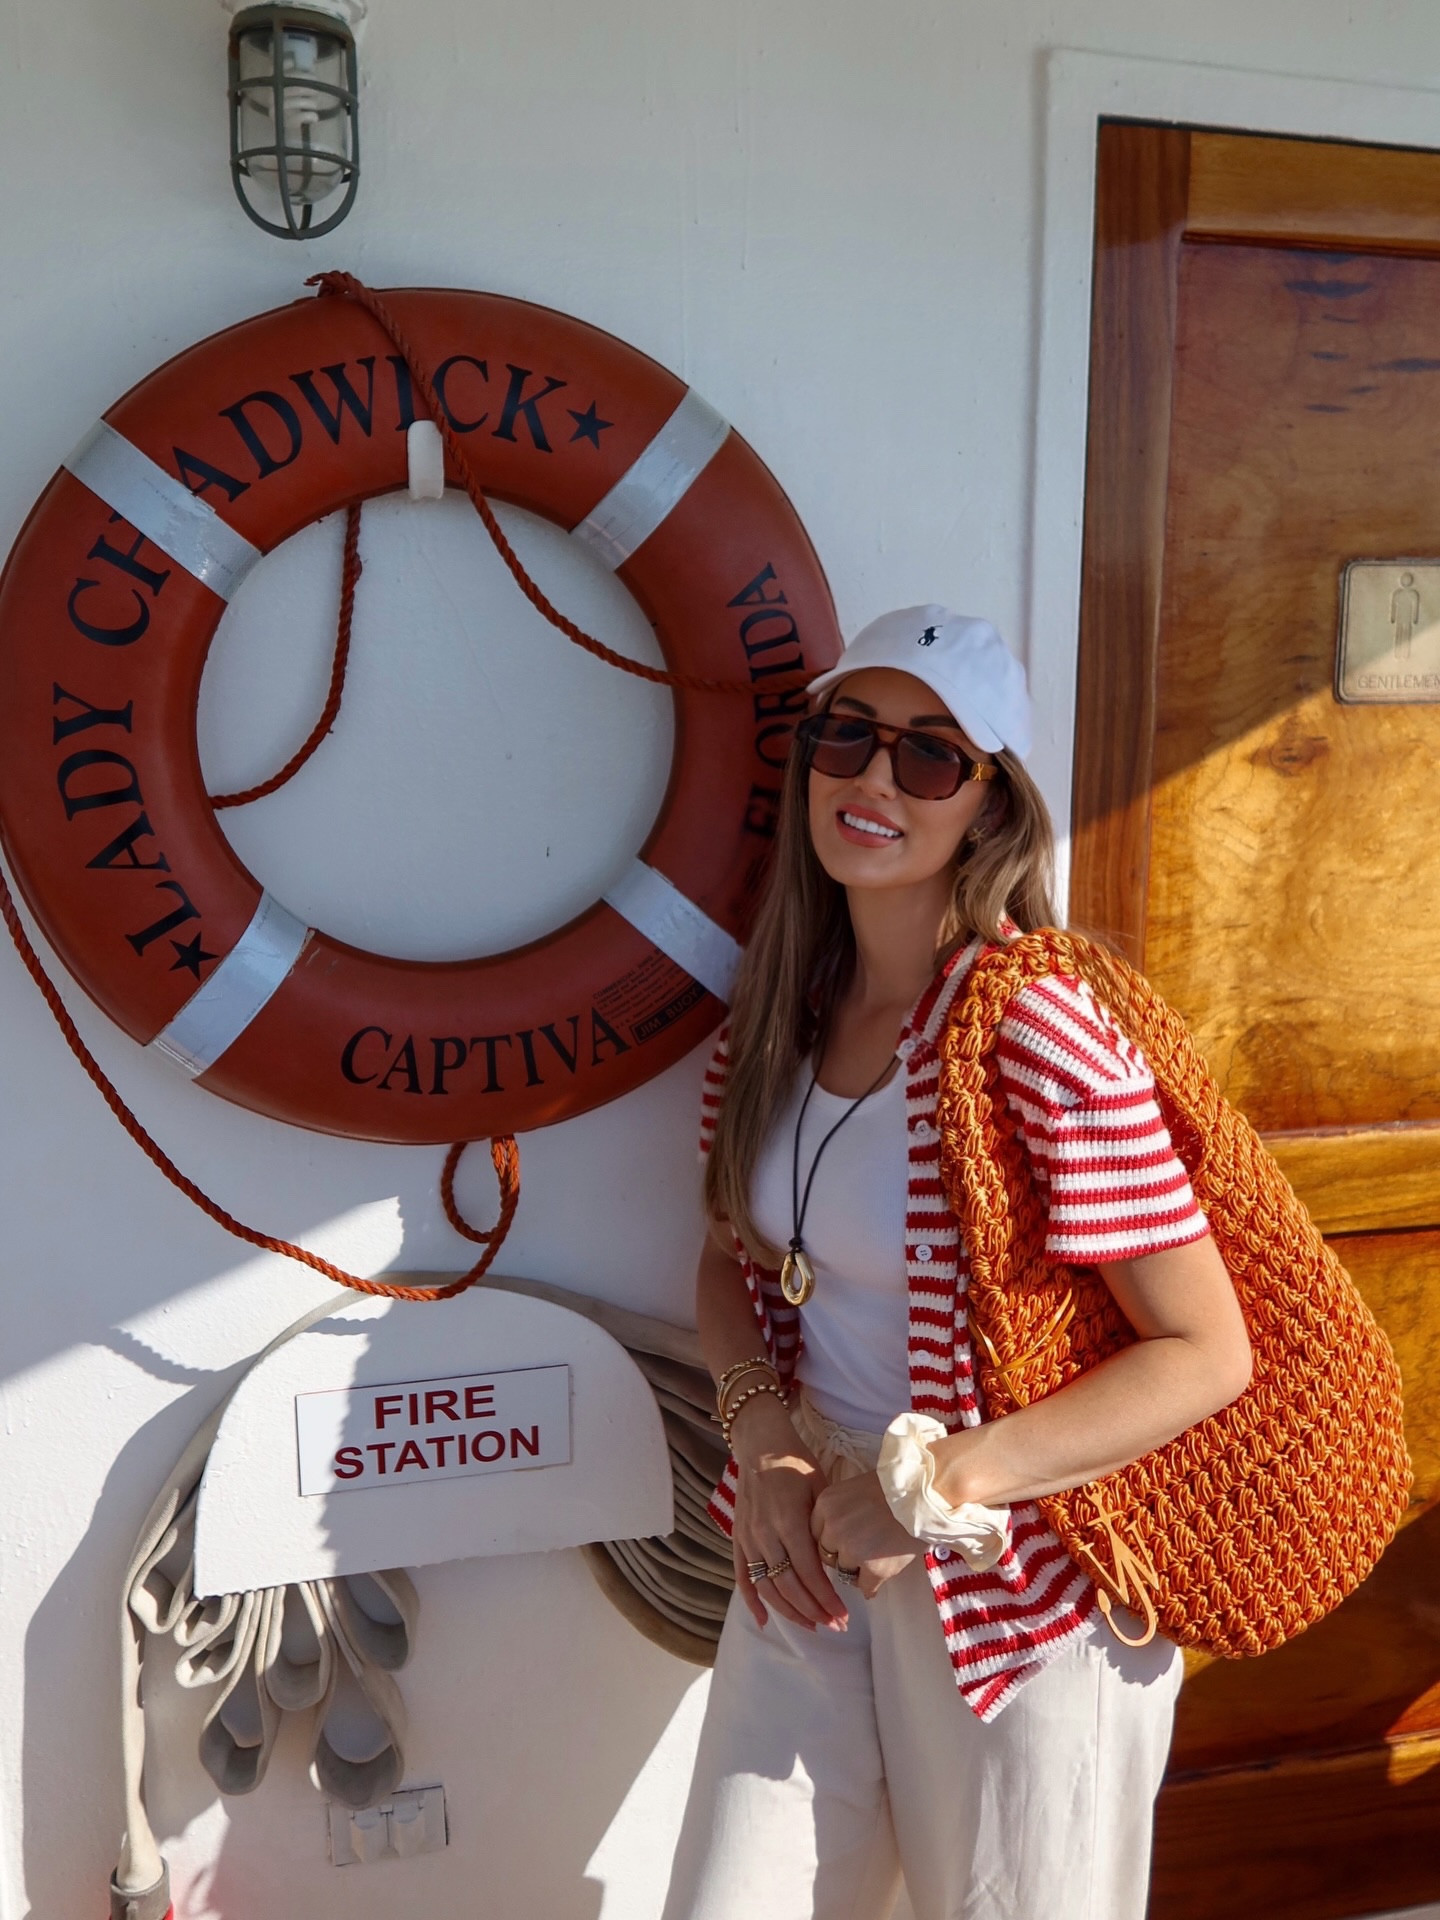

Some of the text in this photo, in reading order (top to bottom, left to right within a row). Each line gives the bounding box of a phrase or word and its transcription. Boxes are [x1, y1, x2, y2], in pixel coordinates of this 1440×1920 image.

[53, 354, 569, 957] LADY CHADWICK
[639, 986, 699, 1037] JIM BUOY
[340, 1007, 632, 1096] CAPTIVA
[374, 1384, 496, 1430] FIRE
[333, 1425, 540, 1480] STATION
